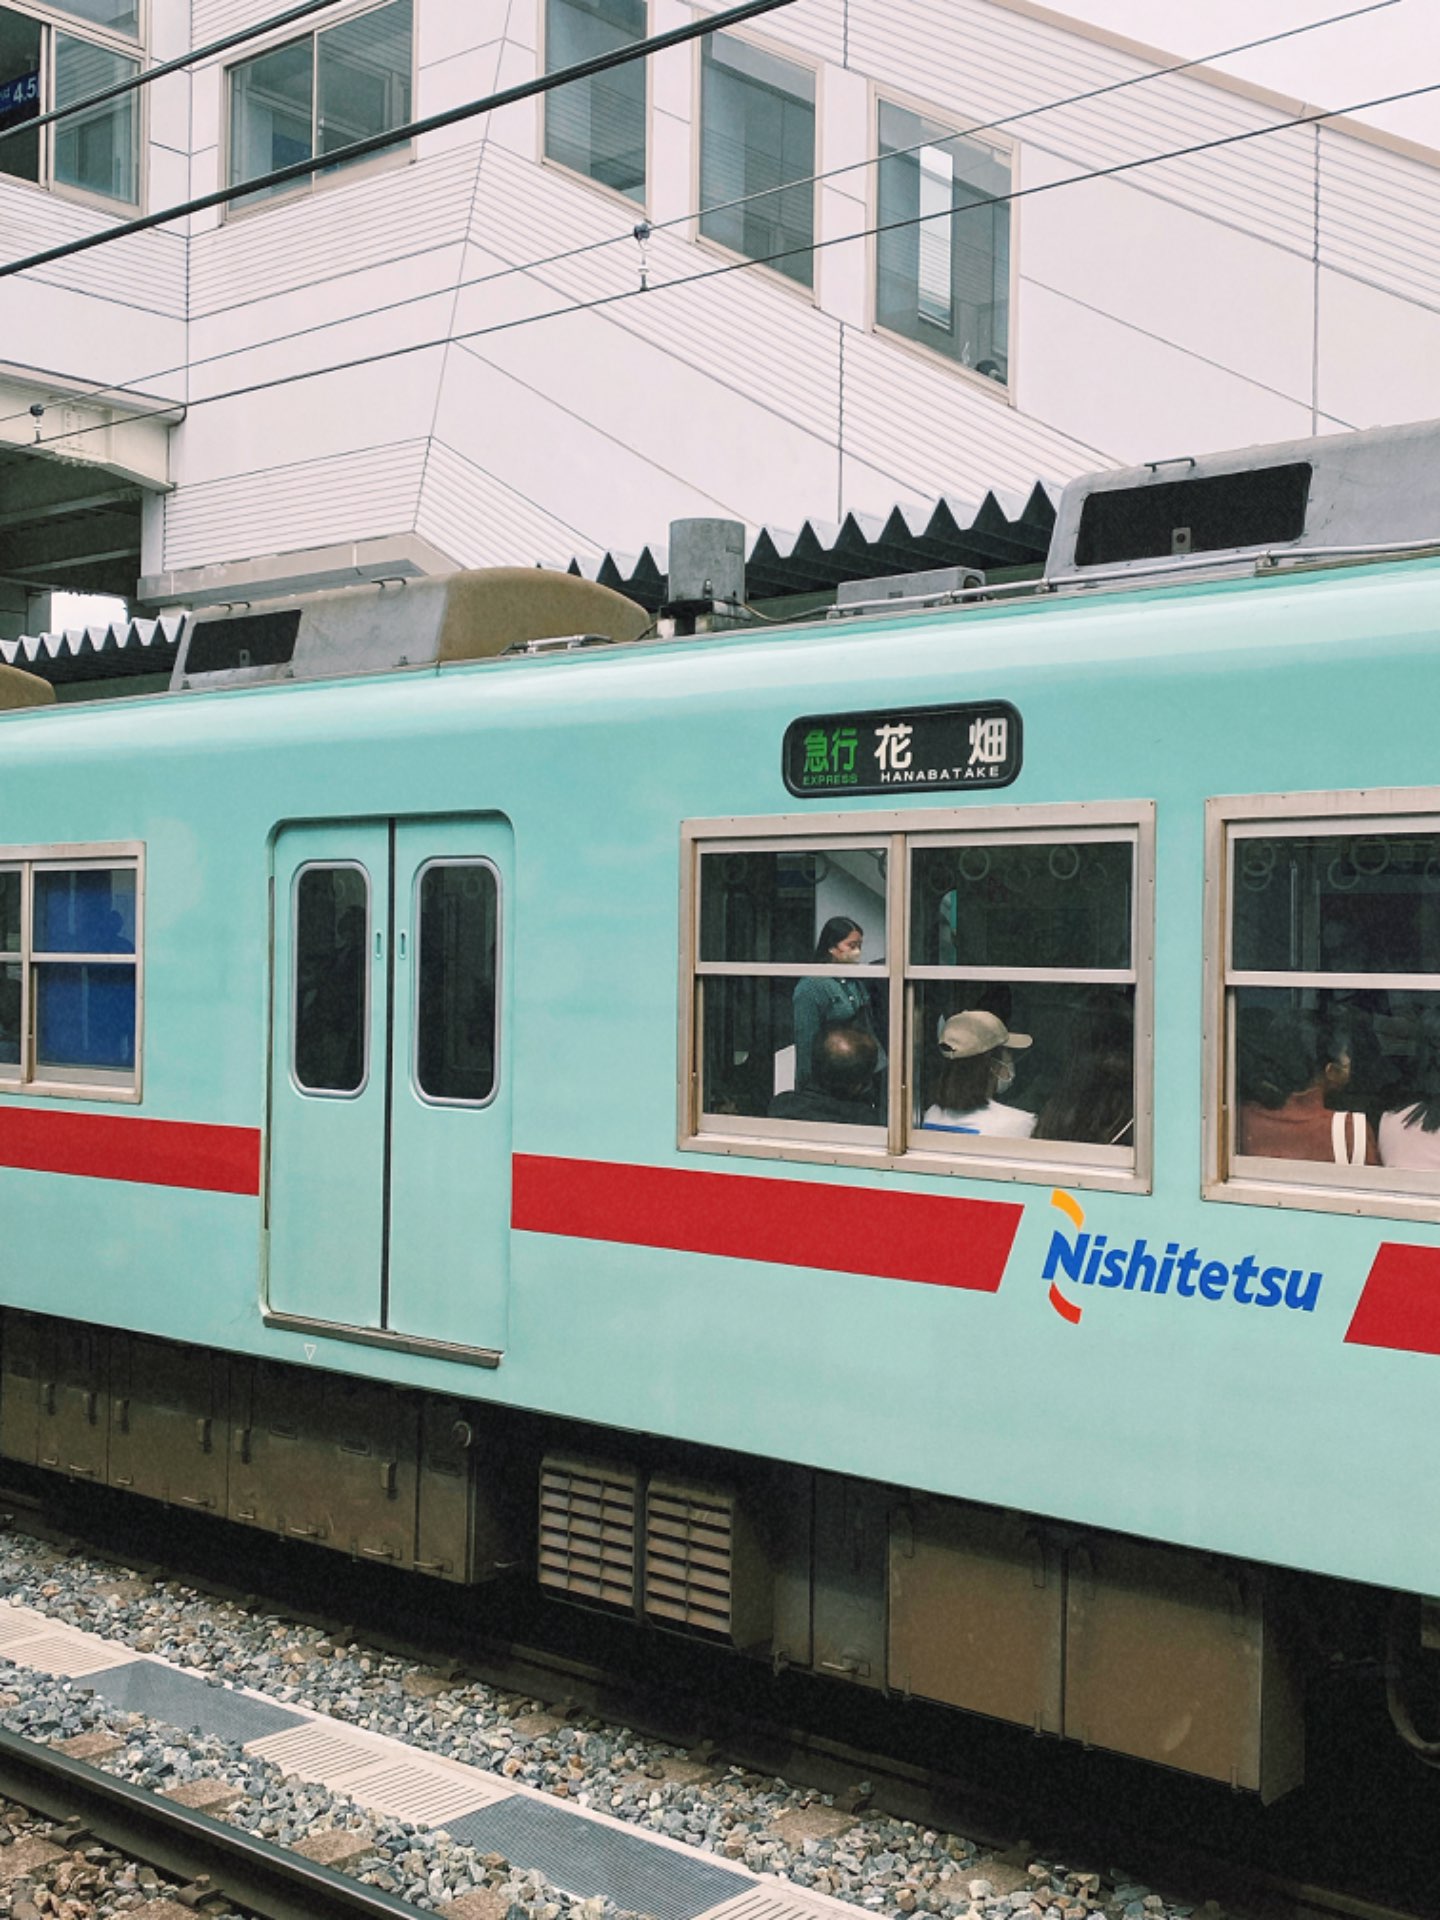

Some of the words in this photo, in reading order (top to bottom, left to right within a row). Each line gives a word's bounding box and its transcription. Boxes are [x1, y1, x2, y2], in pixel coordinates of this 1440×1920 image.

[803, 728, 858, 773] 急行
[802, 773, 858, 786] EXPRESS
[881, 765, 1000, 783] HANABATAKE
[1041, 1230, 1323, 1312] Nishitetsu
